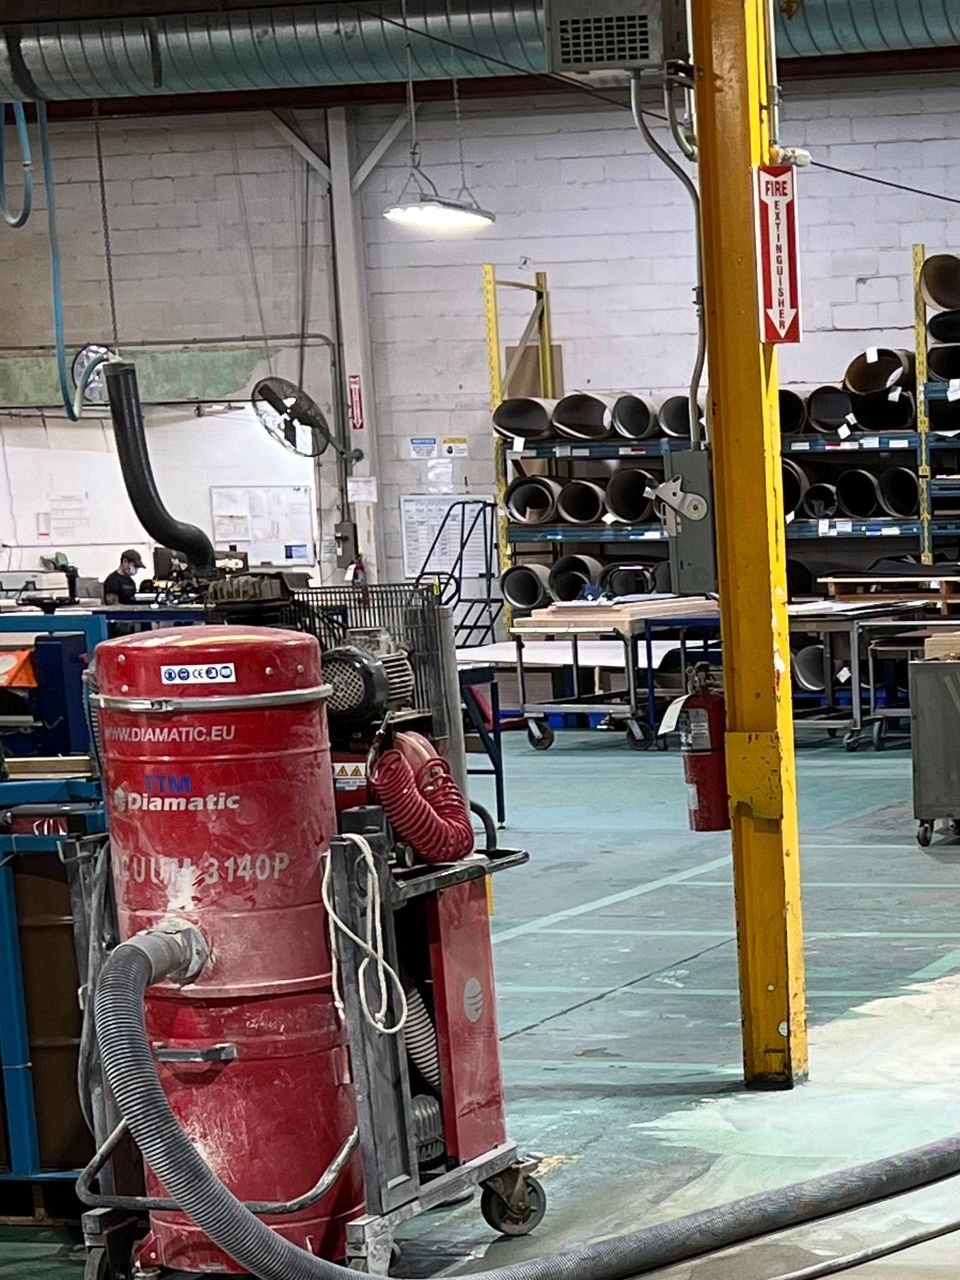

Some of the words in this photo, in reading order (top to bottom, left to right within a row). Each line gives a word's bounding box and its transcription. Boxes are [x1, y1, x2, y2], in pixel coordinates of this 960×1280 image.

[765, 180, 788, 197] FIRE
[774, 200, 786, 330] EXTINGUISHER
[105, 725, 236, 742] WWW.DIAMATIC.EU
[127, 791, 240, 811] Diamatic
[203, 851, 290, 885] 3140P
